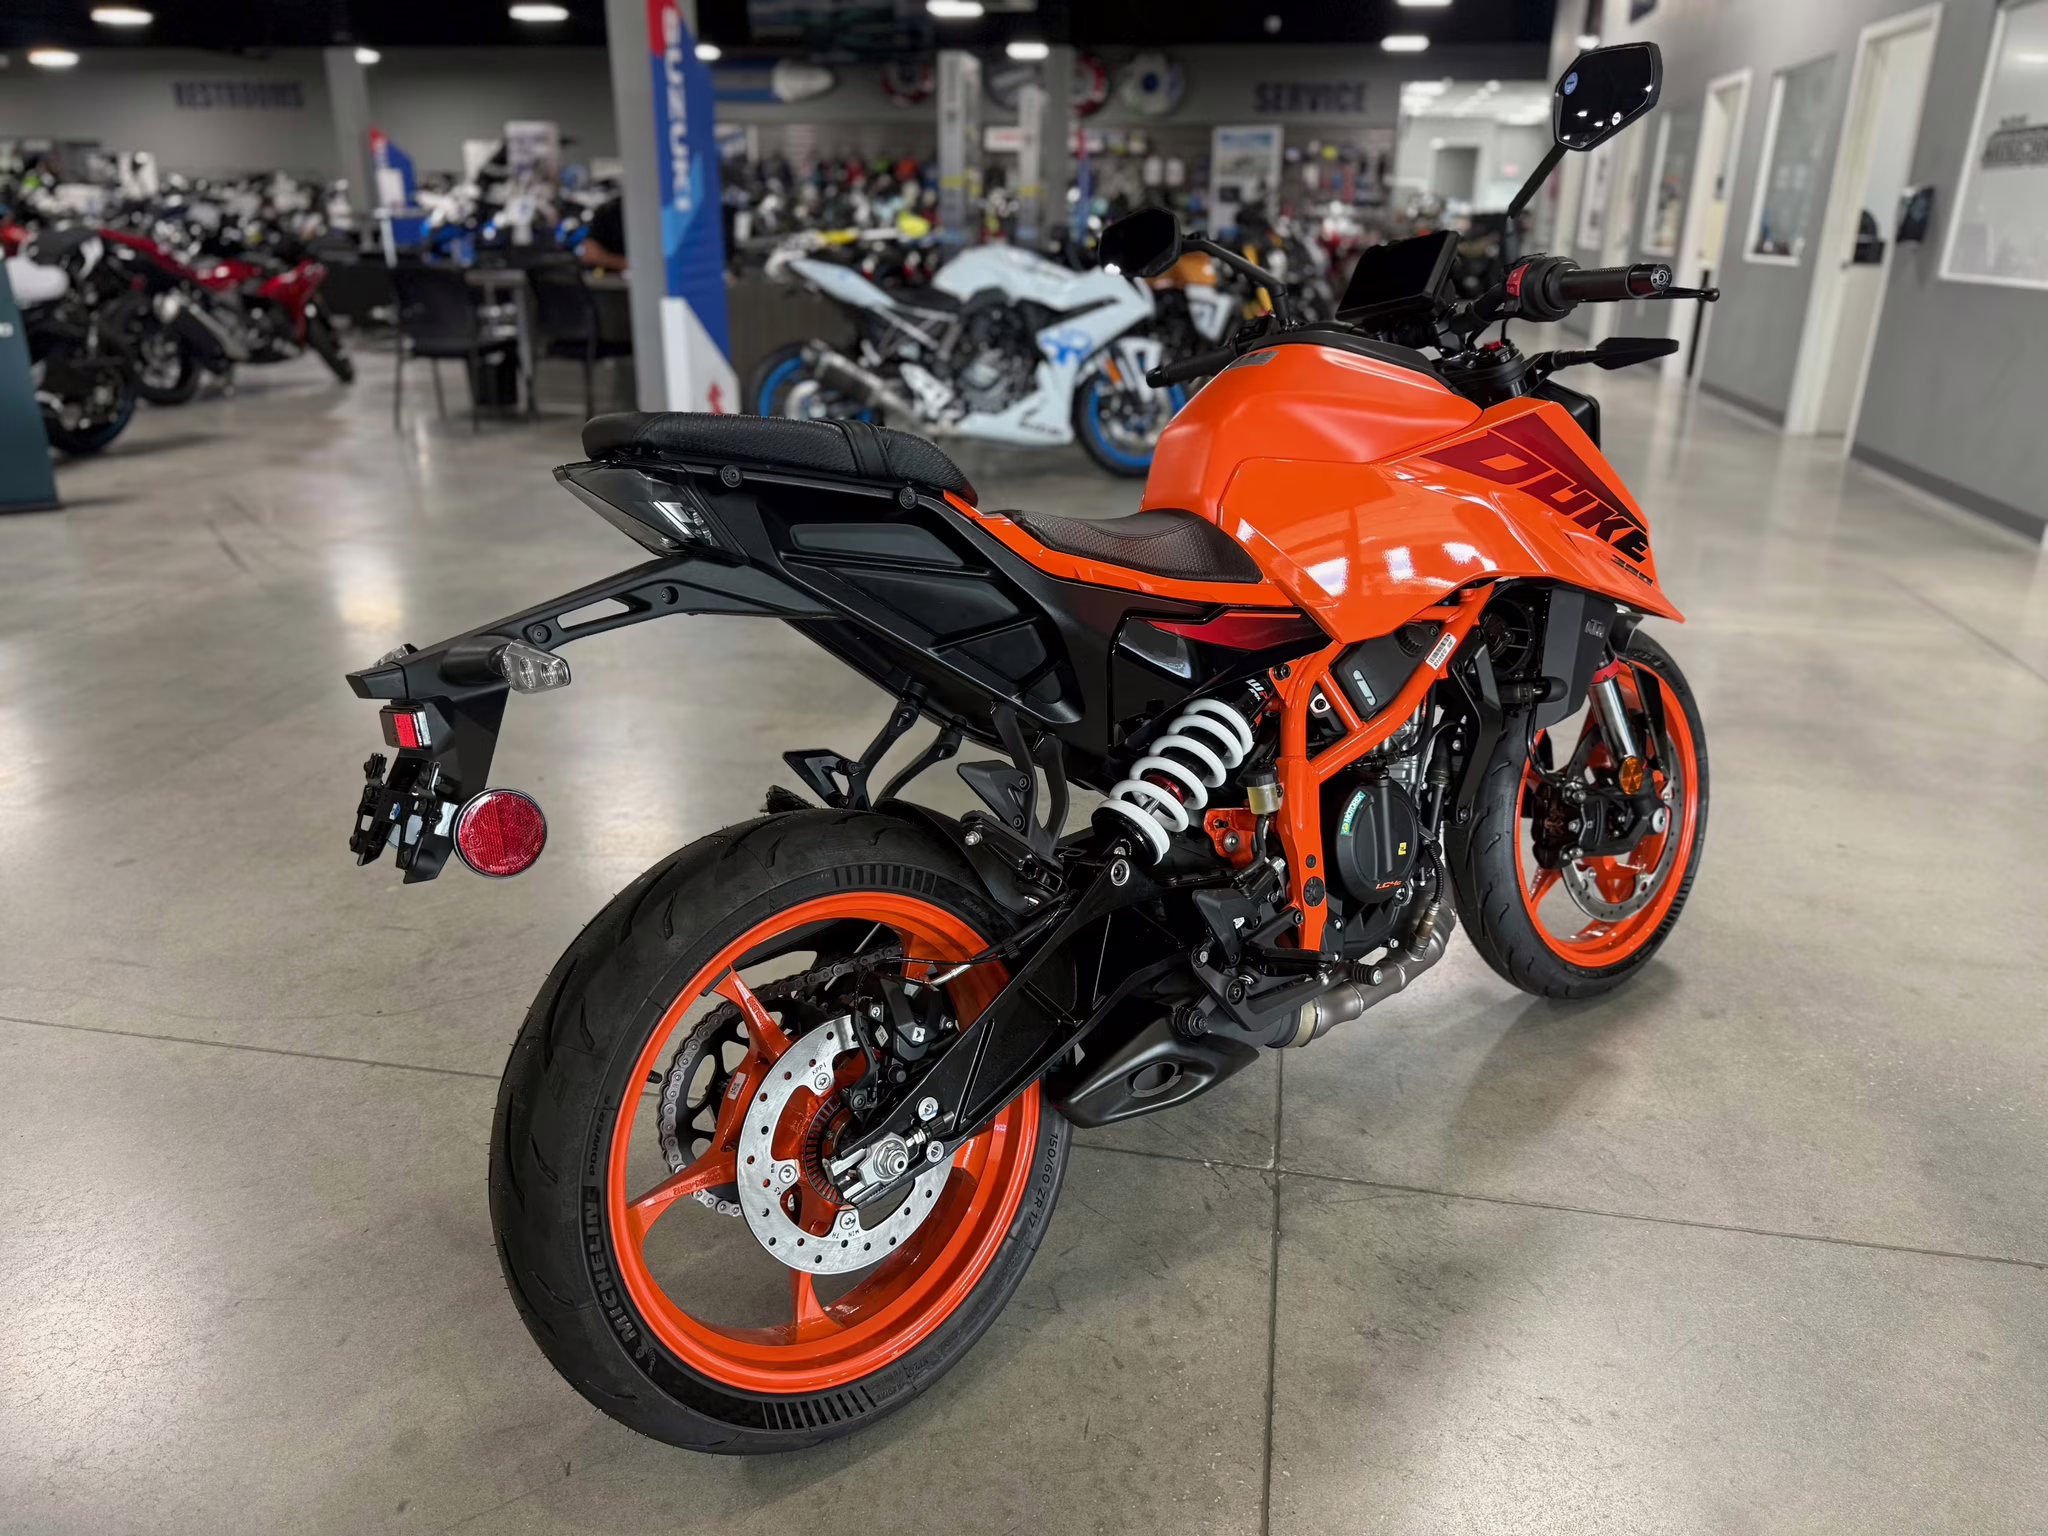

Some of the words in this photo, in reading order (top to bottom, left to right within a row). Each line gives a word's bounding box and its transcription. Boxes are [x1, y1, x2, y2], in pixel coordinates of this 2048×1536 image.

[661, 6, 692, 211] SUZUKI
[1419, 428, 1650, 564] DUKE
[1345, 791, 1364, 824] MOTOREX
[589, 1113, 605, 1176] POWER
[1042, 1133, 1059, 1184] 150/60
[584, 1201, 638, 1344] MICHELIN
